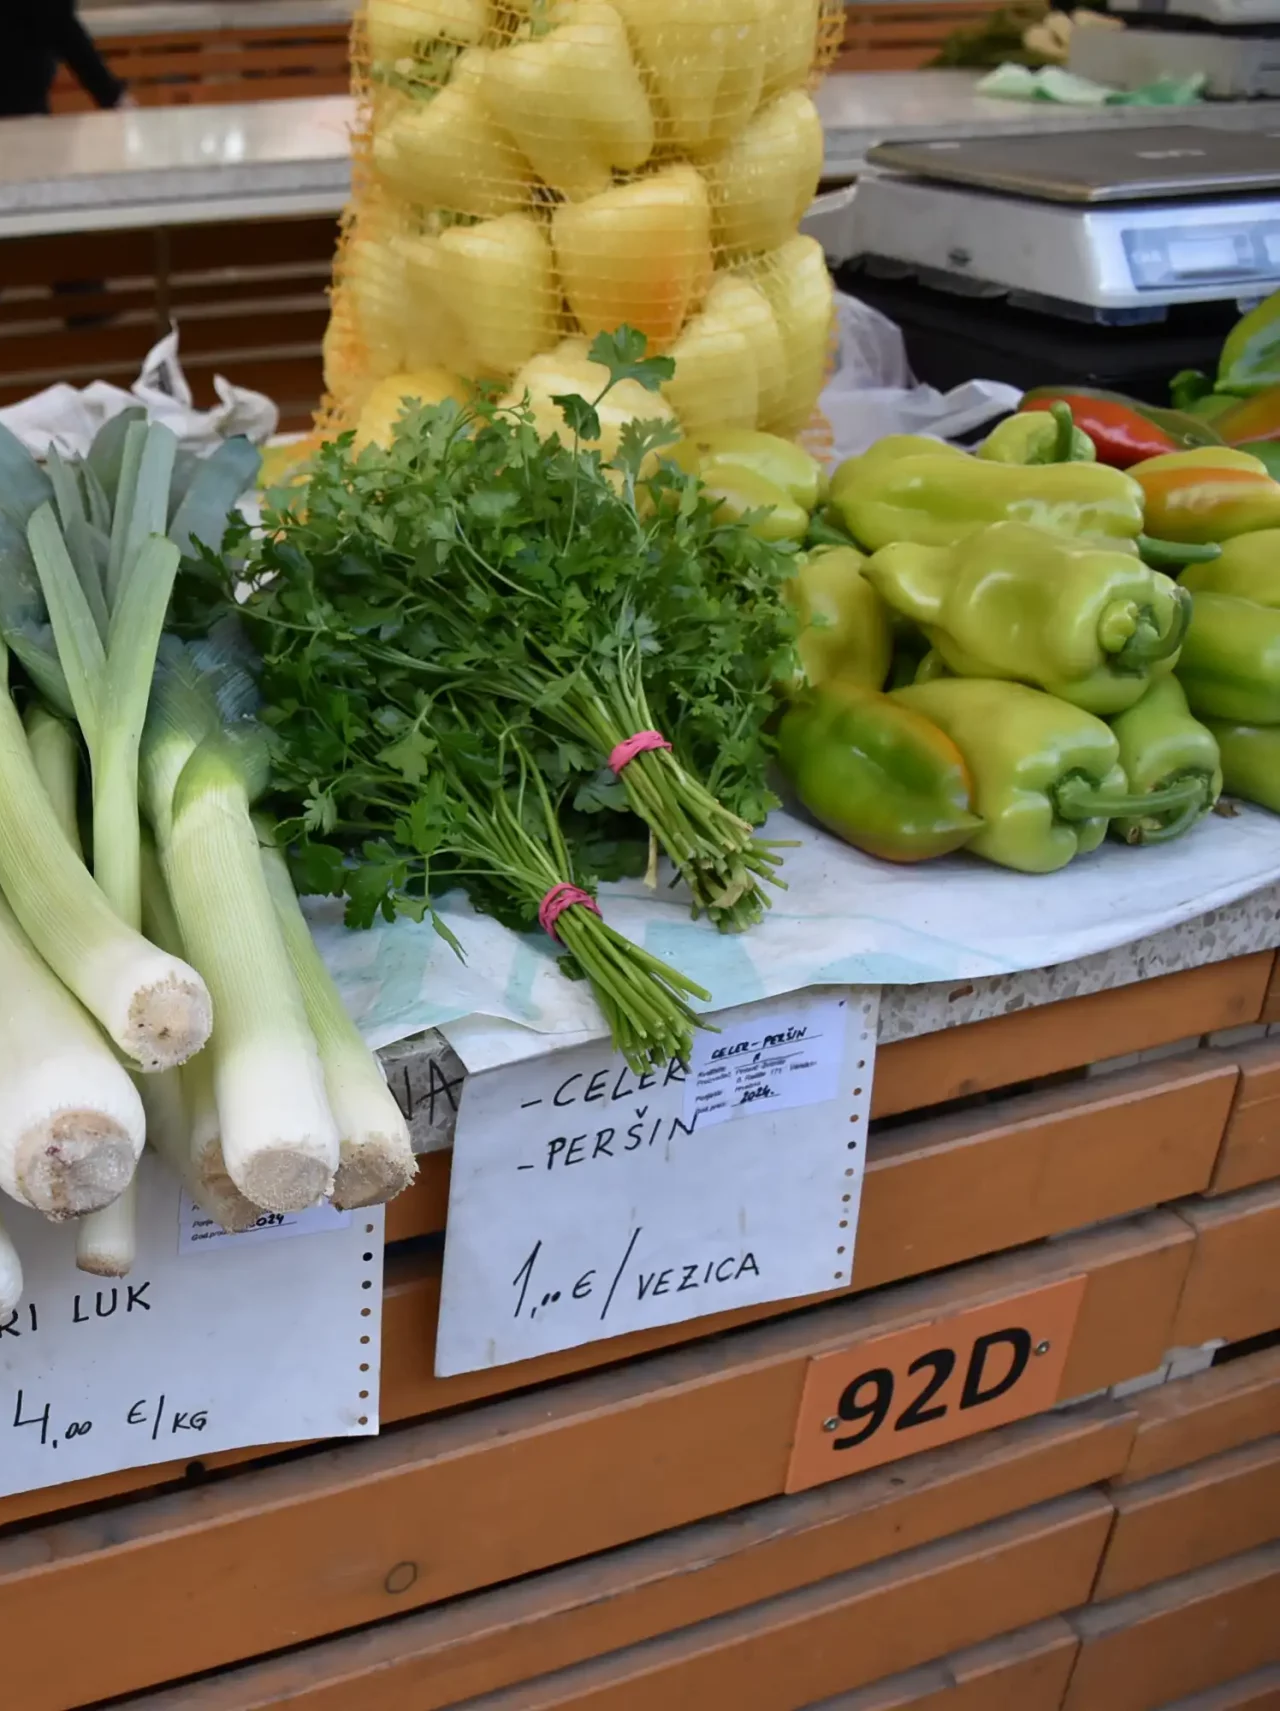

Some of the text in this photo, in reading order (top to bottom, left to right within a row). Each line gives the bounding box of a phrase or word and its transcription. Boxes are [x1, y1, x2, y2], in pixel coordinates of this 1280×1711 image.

[248, 1213, 285, 1228] 024
[73, 1280, 153, 1325] LUK
[831, 1327, 1032, 1452] 92D
